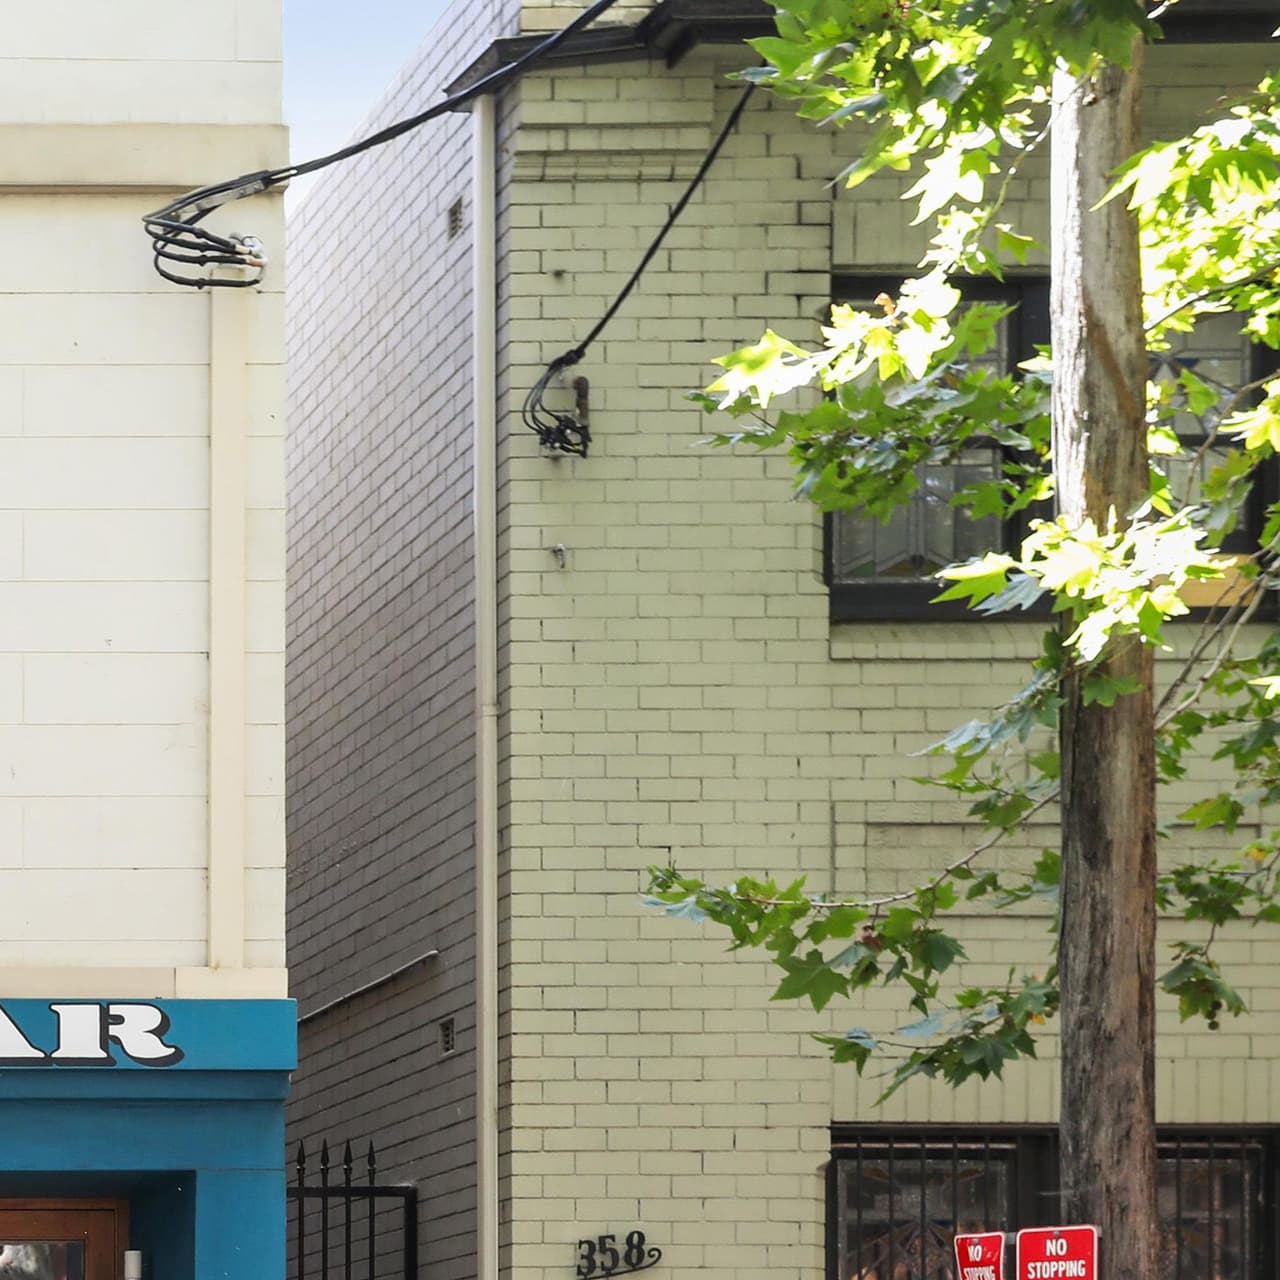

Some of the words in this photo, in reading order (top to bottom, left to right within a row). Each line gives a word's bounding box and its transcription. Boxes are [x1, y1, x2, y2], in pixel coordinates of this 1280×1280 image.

[576, 1230, 646, 1277] 358
[968, 1245, 982, 1262] NO
[1046, 1239, 1067, 1256] NO
[1027, 1260, 1086, 1279] STOPPING
